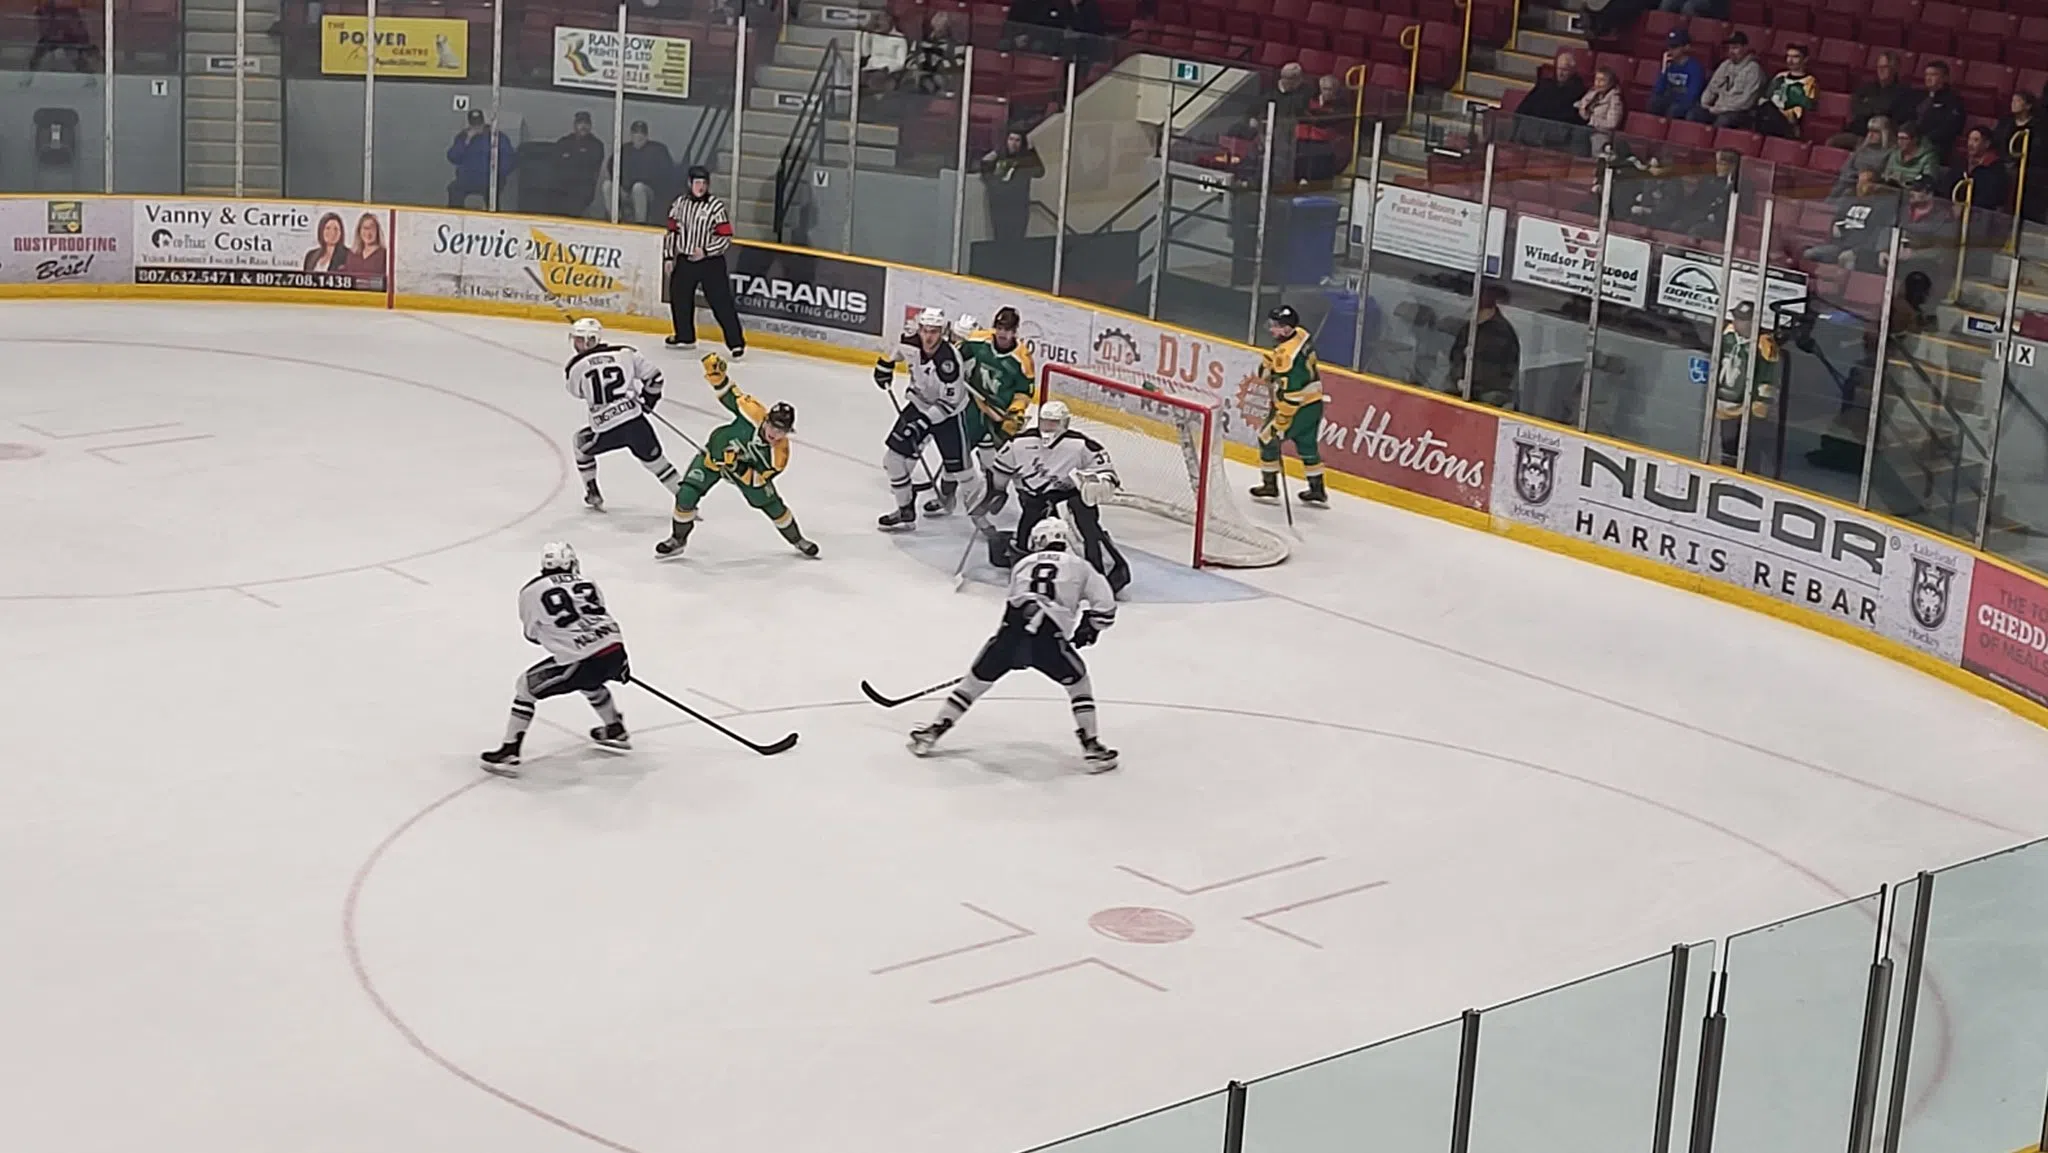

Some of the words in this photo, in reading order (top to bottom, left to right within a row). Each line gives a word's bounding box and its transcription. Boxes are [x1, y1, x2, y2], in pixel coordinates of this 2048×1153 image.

[588, 33, 656, 50] RAINBOW
[155, 81, 164, 94] T
[456, 99, 467, 109] U
[816, 172, 827, 186] V
[146, 204, 213, 229] Vanny
[220, 206, 238, 225] &
[244, 206, 309, 228] Carrie
[13, 237, 117, 252] RUSTPROOFING
[214, 232, 273, 252] Costa
[36, 254, 95, 280] Best!
[1525, 245, 1579, 268] Windsor
[1581, 258, 1639, 282] Plwood
[138, 269, 236, 285] 807.632.5471
[240, 272, 253, 285] &
[256, 272, 352, 289] 807.708.1438
[550, 266, 614, 290] Clean
[729, 273, 868, 314] TARANIS
[735, 297, 823, 319] CONTRACTING
[824, 309, 867, 325] GROUP
[1040, 342, 1078, 365] FUELS
[1157, 332, 1225, 390] DJ's
[2019, 346, 2032, 364] X
[584, 365, 627, 405] 12
[1352, 404, 1485, 489] Hortons
[1580, 446, 1887, 575] NUCOR
[1575, 509, 1728, 574] HARRIS
[1753, 560, 1878, 627] REBAR
[1029, 562, 1059, 601] 8
[540, 582, 606, 629] 93
[2000, 589, 2025, 609] THE
[1977, 604, 2048, 656] CHEDD
[1979, 633, 1998, 649] OF
